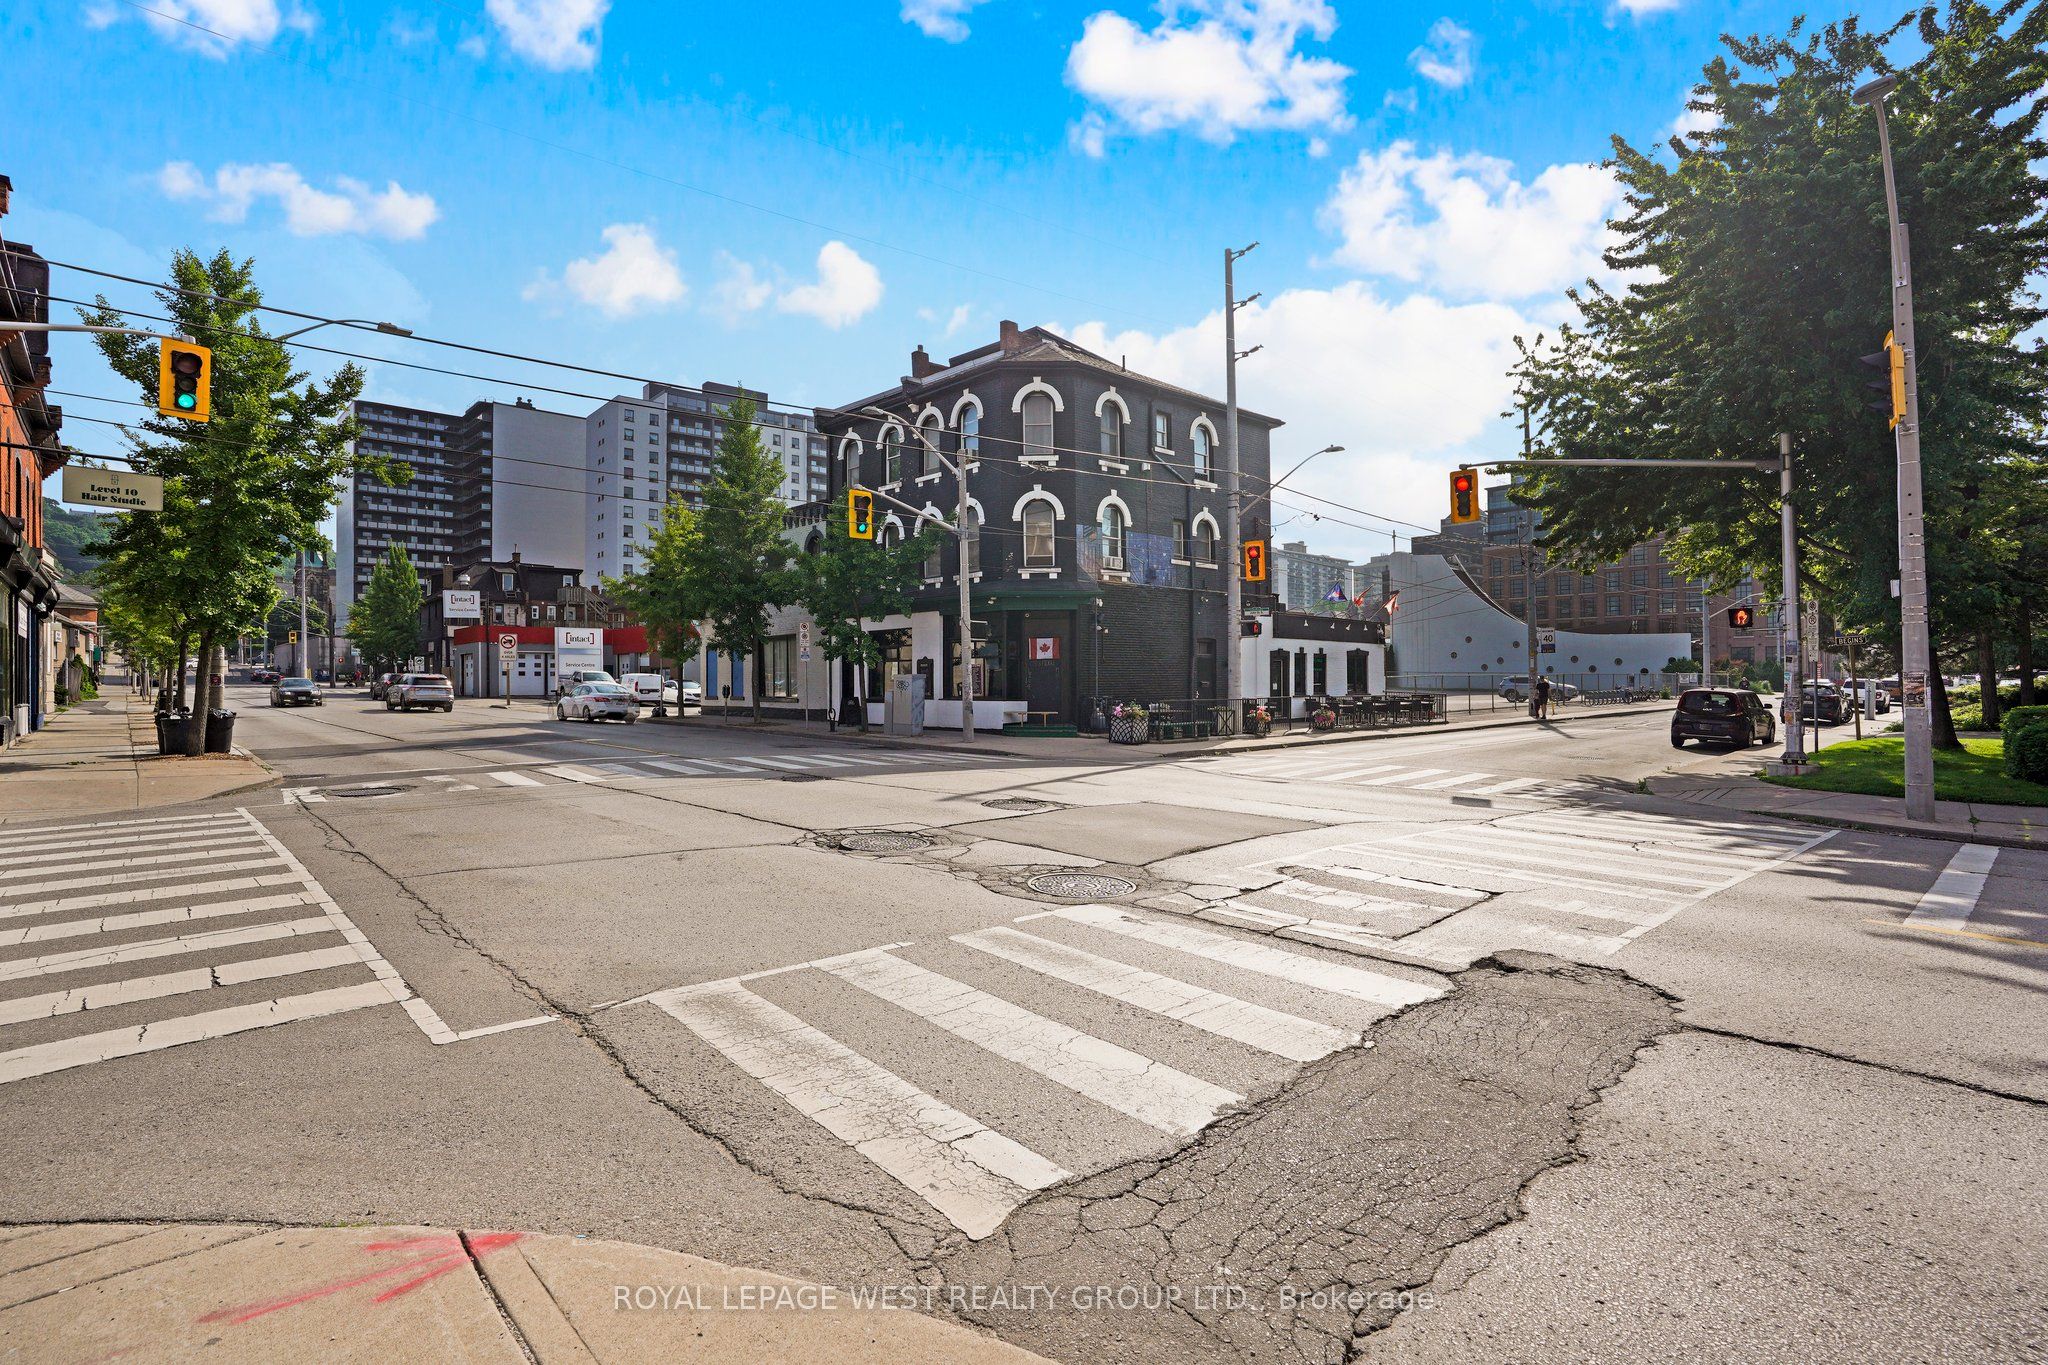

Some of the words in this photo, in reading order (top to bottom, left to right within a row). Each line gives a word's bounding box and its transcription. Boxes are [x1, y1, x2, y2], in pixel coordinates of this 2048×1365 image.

[90, 484, 121, 495] Level
[125, 488, 139, 496] 10
[81, 492, 108, 502] Hair
[110, 495, 146, 506] Studio
[1838, 637, 1864, 645] BEGINS
